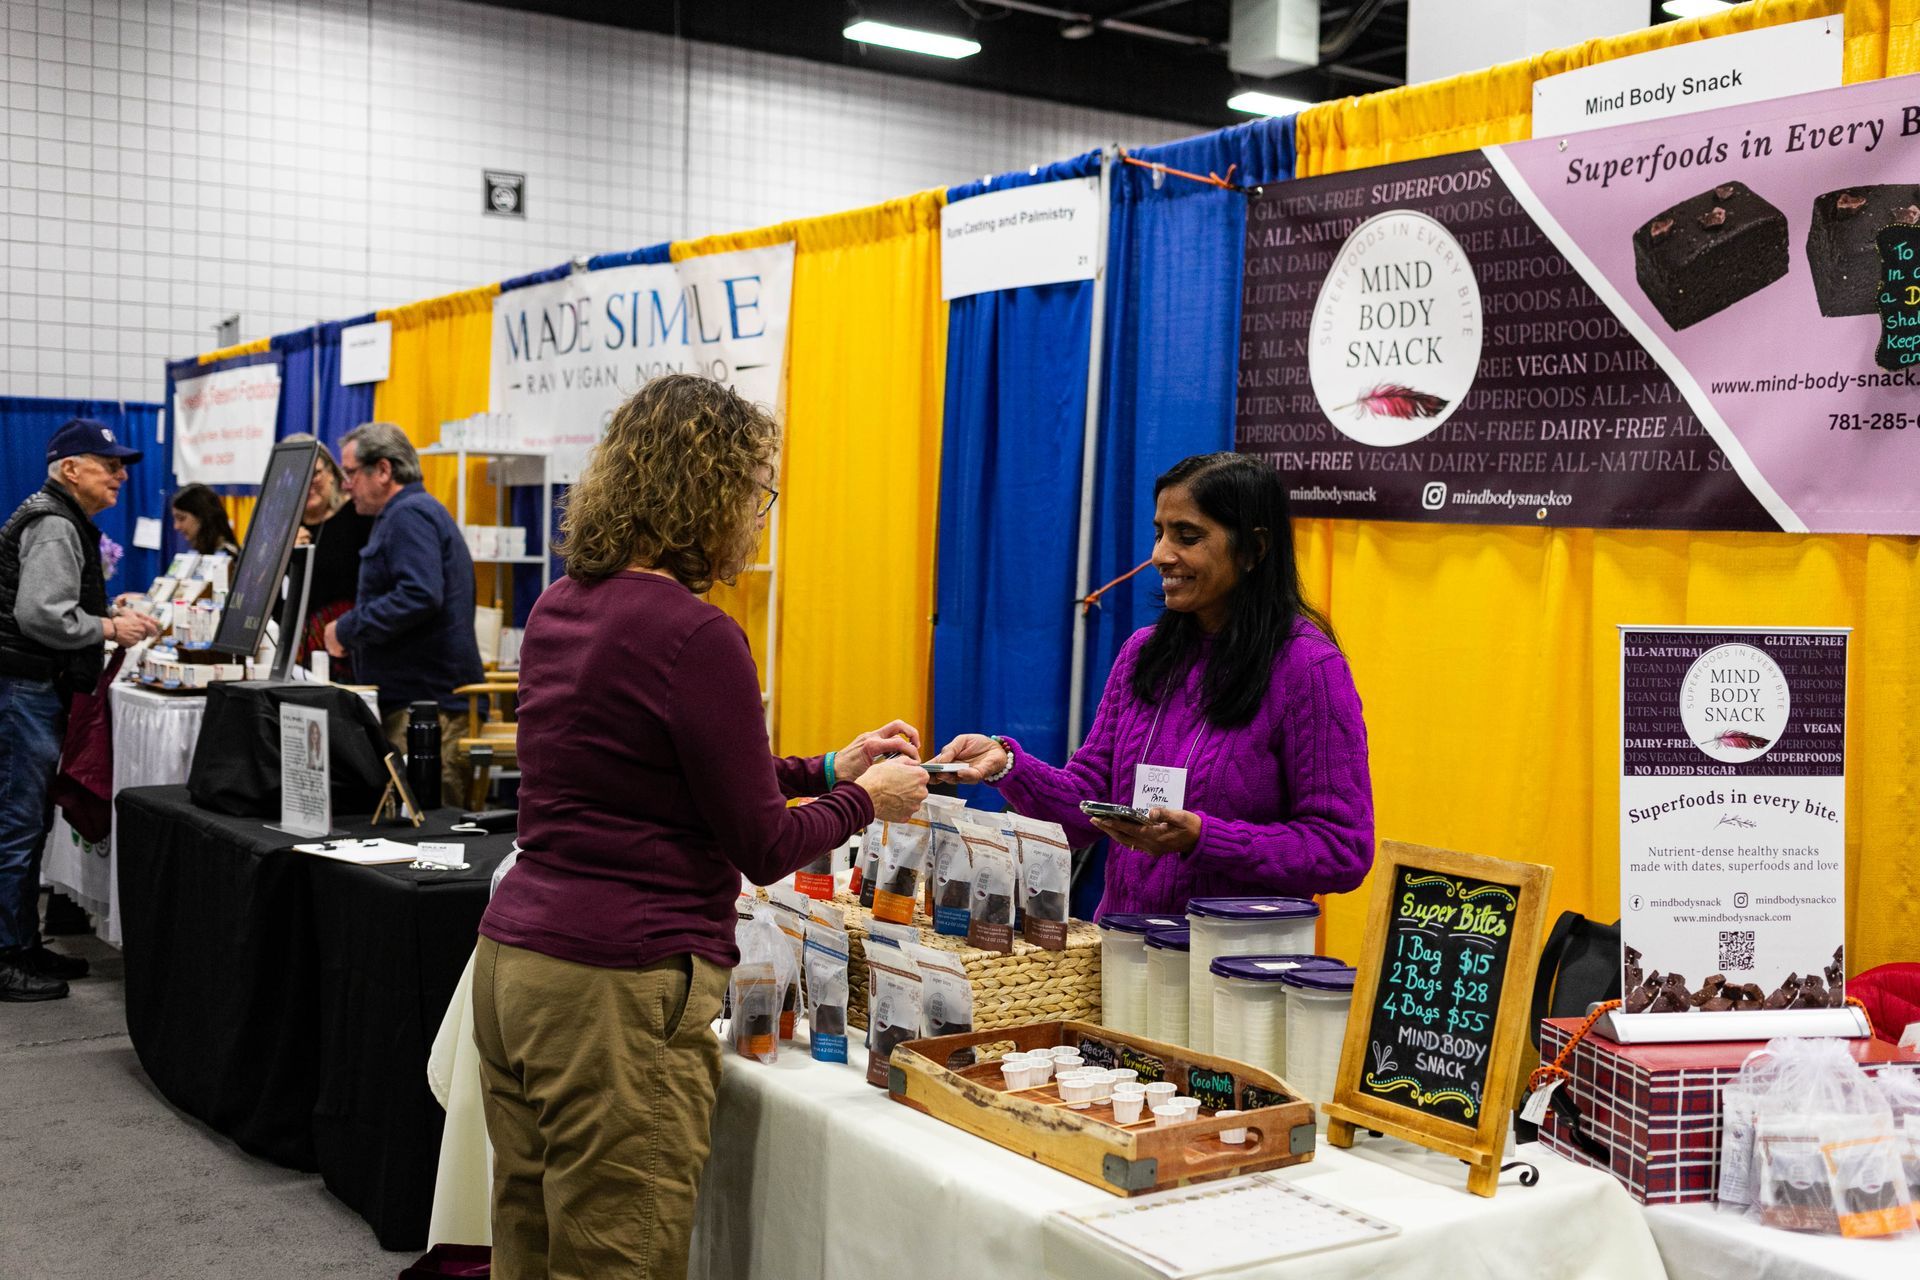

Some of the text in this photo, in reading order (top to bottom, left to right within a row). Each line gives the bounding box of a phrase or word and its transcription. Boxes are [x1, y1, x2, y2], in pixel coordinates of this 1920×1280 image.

[1585, 69, 1743, 115] Mind Body Snack
[1566, 136, 1729, 188] Superfoods
[1740, 129, 1772, 159] in
[1785, 118, 1885, 152] Every
[1255, 167, 1493, 220] GLUTEN-FREE SUPERFOODS
[998, 213, 1018, 229] and
[1019, 205, 1077, 226] Palmistry
[1456, 231, 1495, 253] REE
[1499, 226, 1550, 249] ALL-
[1893, 241, 1914, 261] To
[1361, 261, 1433, 294] MIND
[1359, 298, 1435, 332] BODY
[1346, 336, 1444, 368] SNACK
[1517, 352, 1588, 377] VEGAN
[1460, 387, 1587, 411] UPERFOODS
[1540, 415, 1668, 441] DAIRY-FREE
[1255, 451, 1354, 471] TEN-FREE
[1358, 451, 1424, 472] VEGAN
[1429, 452, 1548, 473] DAIRY-FREE
[1551, 450, 1702, 473] ALL-NATURAL
[1289, 484, 1377, 504] mindbodysnack
[1452, 489, 1572, 510] mindbodysnackco
[1655, 634, 1695, 645] VEGAN
[1764, 635, 1845, 647] GLUTEN-FREE
[1625, 663, 1665, 674] VEGAN
[1710, 668, 1761, 684] MIND
[1625, 692, 1658, 703] EGAN
[1710, 688, 1761, 703] BODY
[1704, 707, 1766, 722] SNACK
[1803, 723, 1842, 733] VEGAN
[1624, 738, 1697, 749] DAIRY-FREE
[1649, 752, 1688, 762] VEGAN
[1766, 752, 1842, 763] SUPERFOODS
[1634, 765, 1841, 776] NO ADDED SUGAR VEGAN DAIRY-FREE
[1628, 789, 1840, 824] Superfoods in every bite.
[1648, 845, 1820, 860] Nutrient-dense healthy snacks
[1630, 860, 1840, 874] made with dates, superfoods and love
[1650, 897, 1722, 910] mindbodysnack
[1755, 895, 1837, 907] mindbodysnackco
[1400, 893, 1508, 937] Super Bites
[1673, 912, 1792, 925] www.mindbodysnack.com
[1397, 935, 1496, 977] 1 Bag $15
[1389, 962, 1489, 1006] 2 Bags $28
[1382, 992, 1490, 1033] 4 Bags $55
[1415, 1052, 1467, 1080] SNACK
